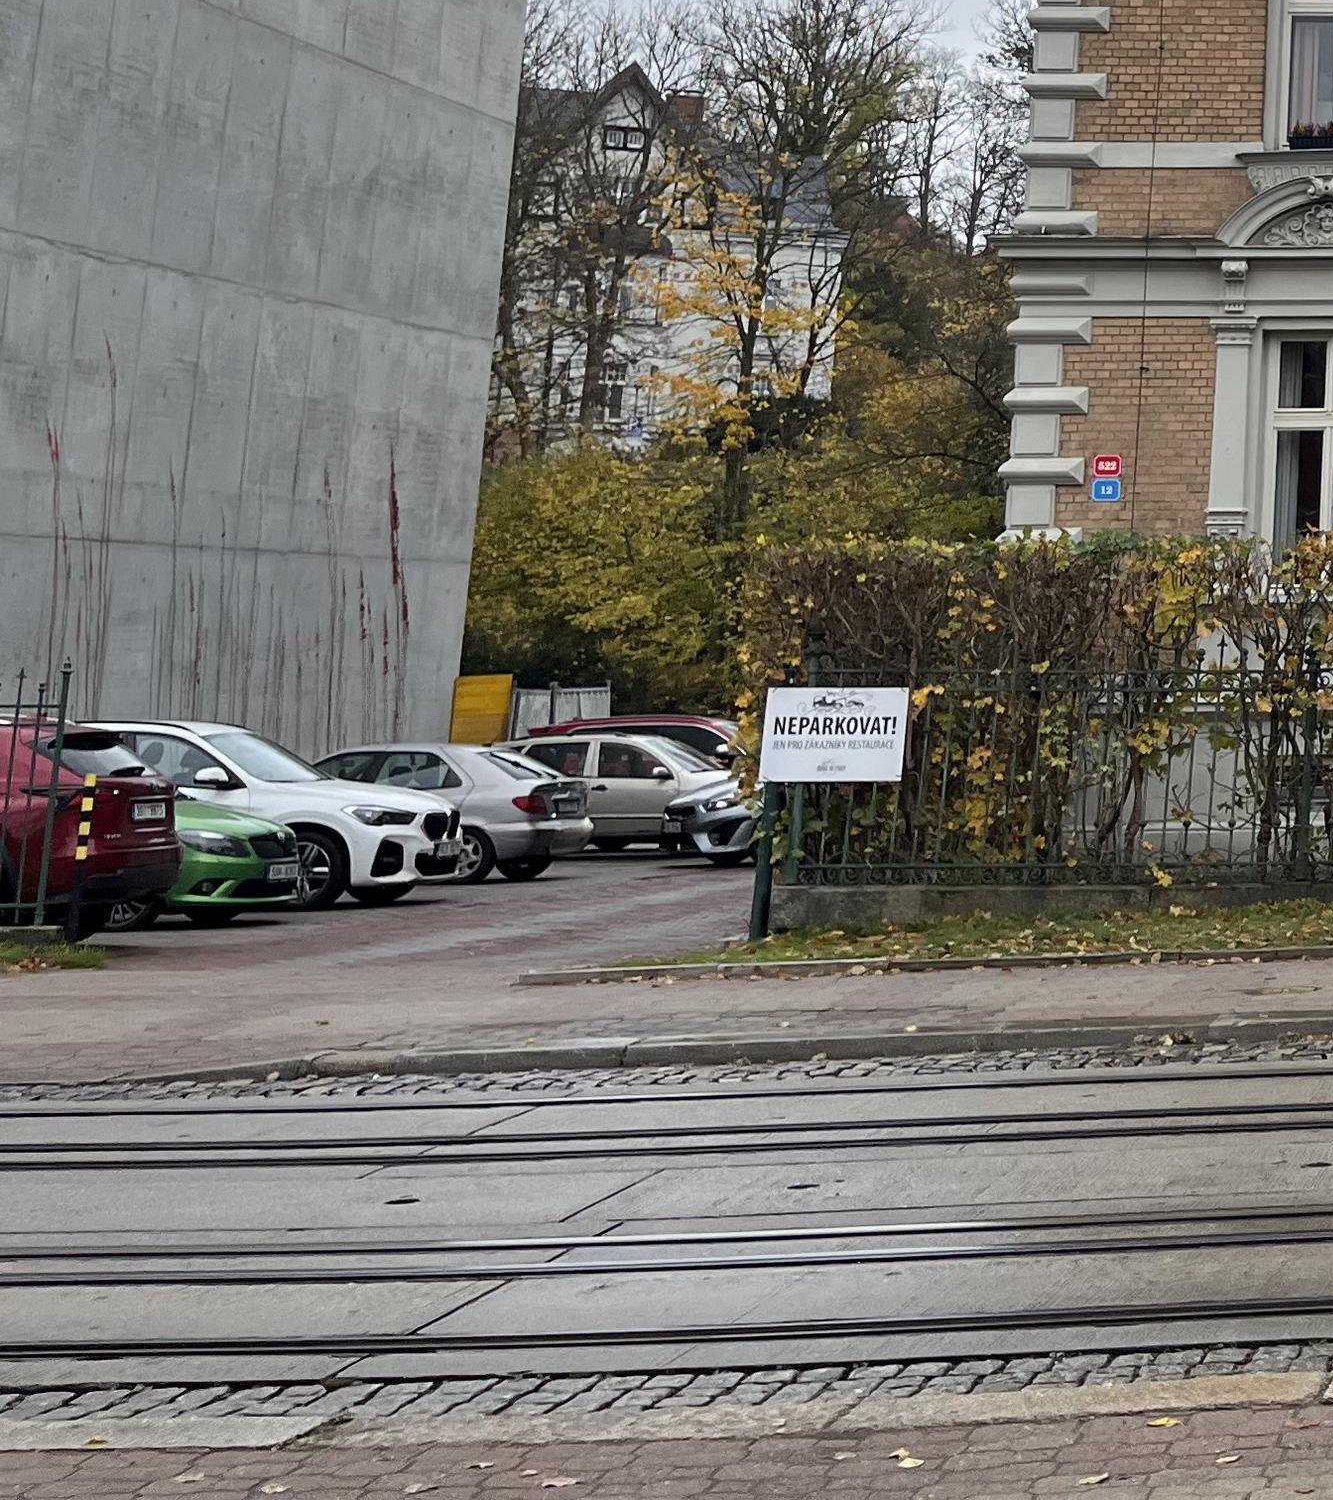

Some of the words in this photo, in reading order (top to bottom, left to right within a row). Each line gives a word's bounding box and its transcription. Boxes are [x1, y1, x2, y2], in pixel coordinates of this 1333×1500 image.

[1101, 485, 1113, 495] 12
[773, 716, 897, 735] NEPARKOVAT!
[772, 740, 786, 750] JEN
[787, 740, 803, 750] PRO
[848, 739, 895, 750] RESTAURACE
